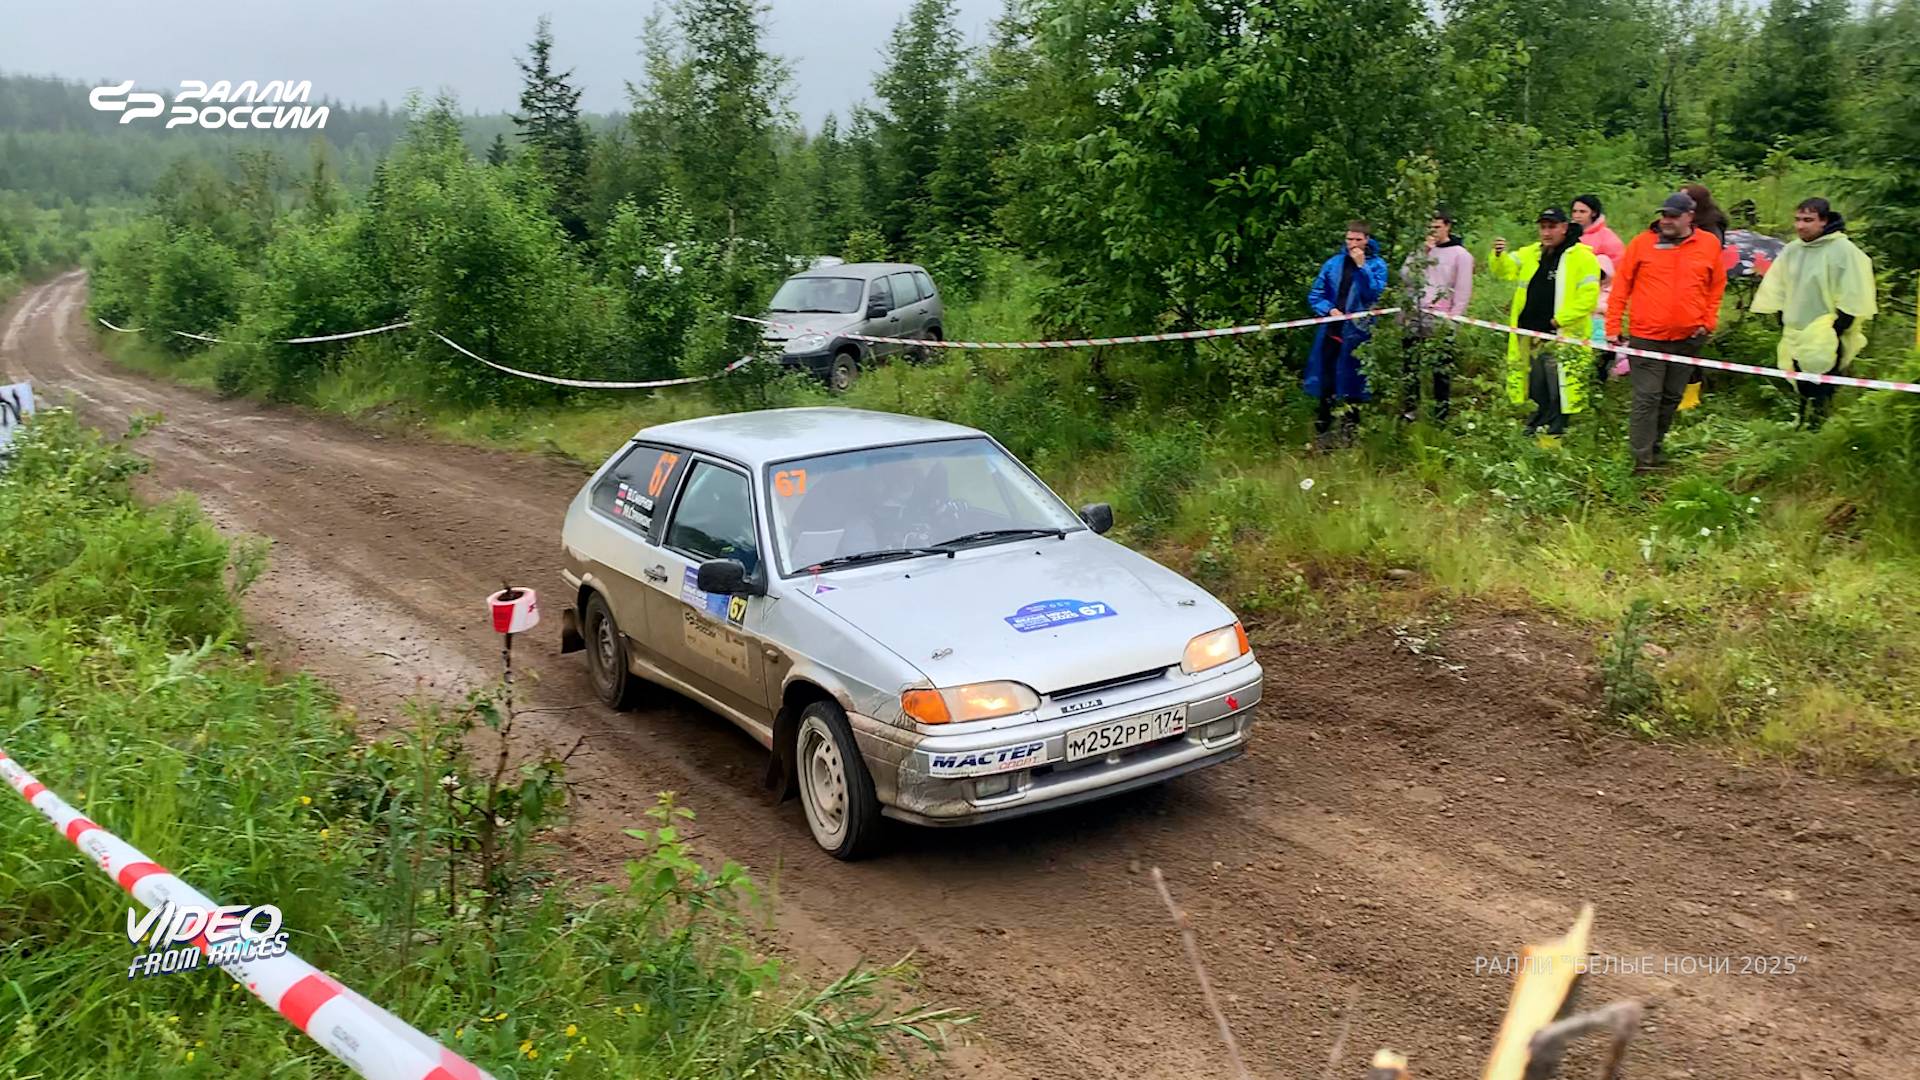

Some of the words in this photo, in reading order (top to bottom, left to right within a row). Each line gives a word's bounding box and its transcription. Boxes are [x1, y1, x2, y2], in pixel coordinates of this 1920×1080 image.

[648, 452, 679, 496] 67
[775, 469, 806, 497] 67
[730, 596, 748, 620] 67
[1079, 604, 1105, 616] 67
[1066, 699, 1099, 712] LADA
[1073, 723, 1149, 757] М252РР
[1154, 710, 1184, 734] 174
[932, 741, 1045, 768] МАСТЕР
